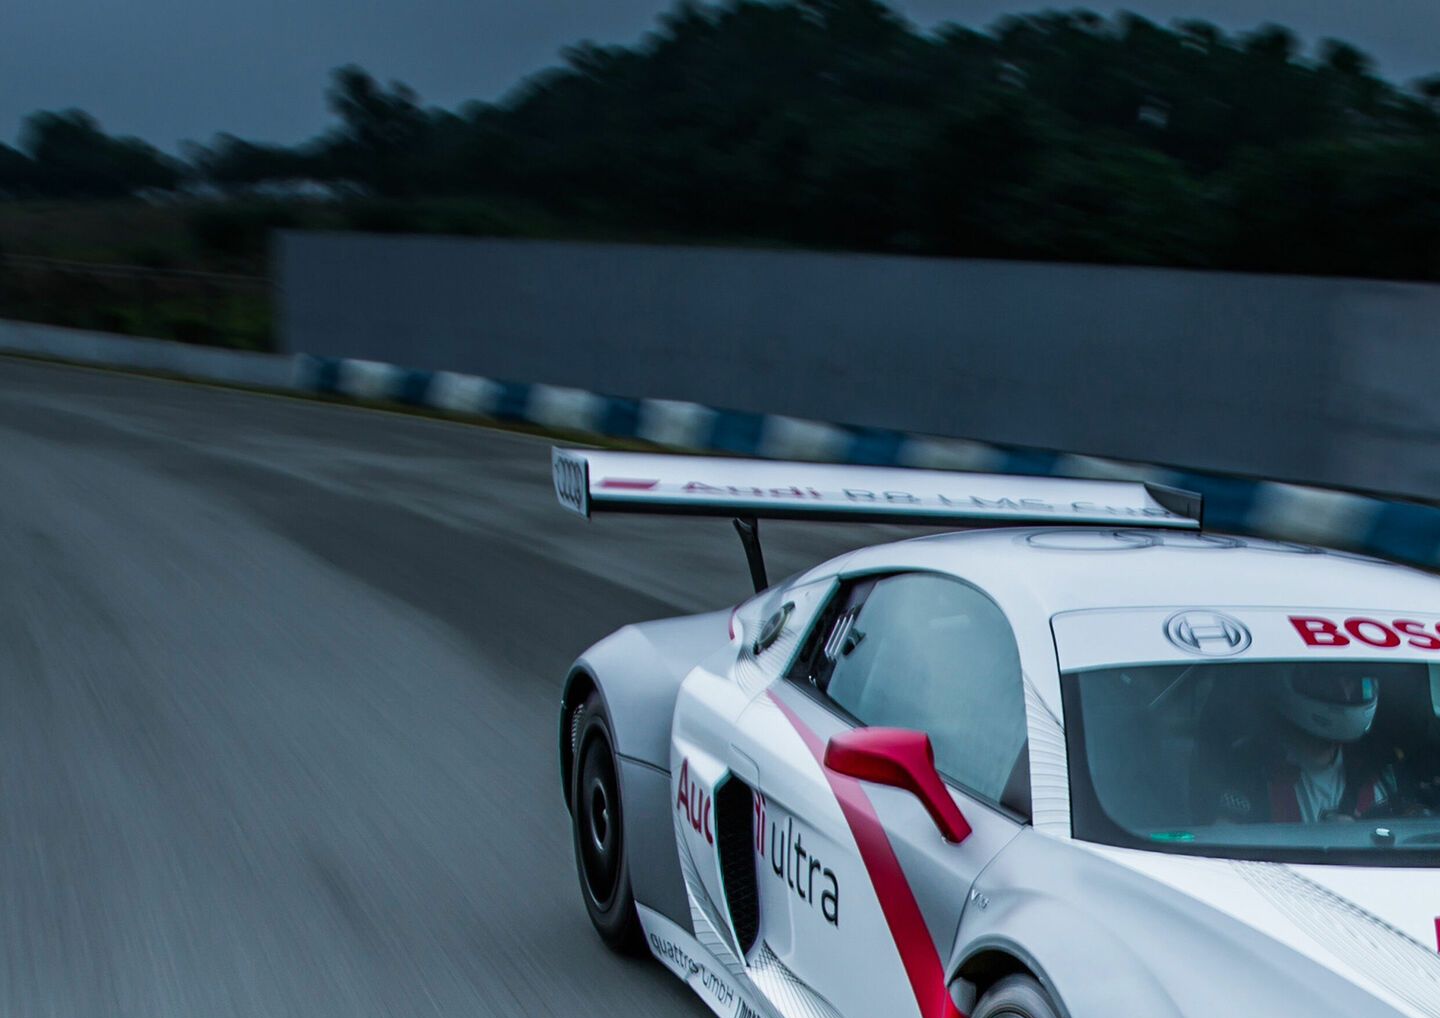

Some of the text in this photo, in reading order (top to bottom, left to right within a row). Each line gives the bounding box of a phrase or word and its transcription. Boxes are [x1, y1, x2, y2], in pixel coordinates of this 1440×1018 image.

[681, 480, 824, 500] Audi
[771, 816, 840, 930] ultra
[650, 933, 699, 974] quattro
